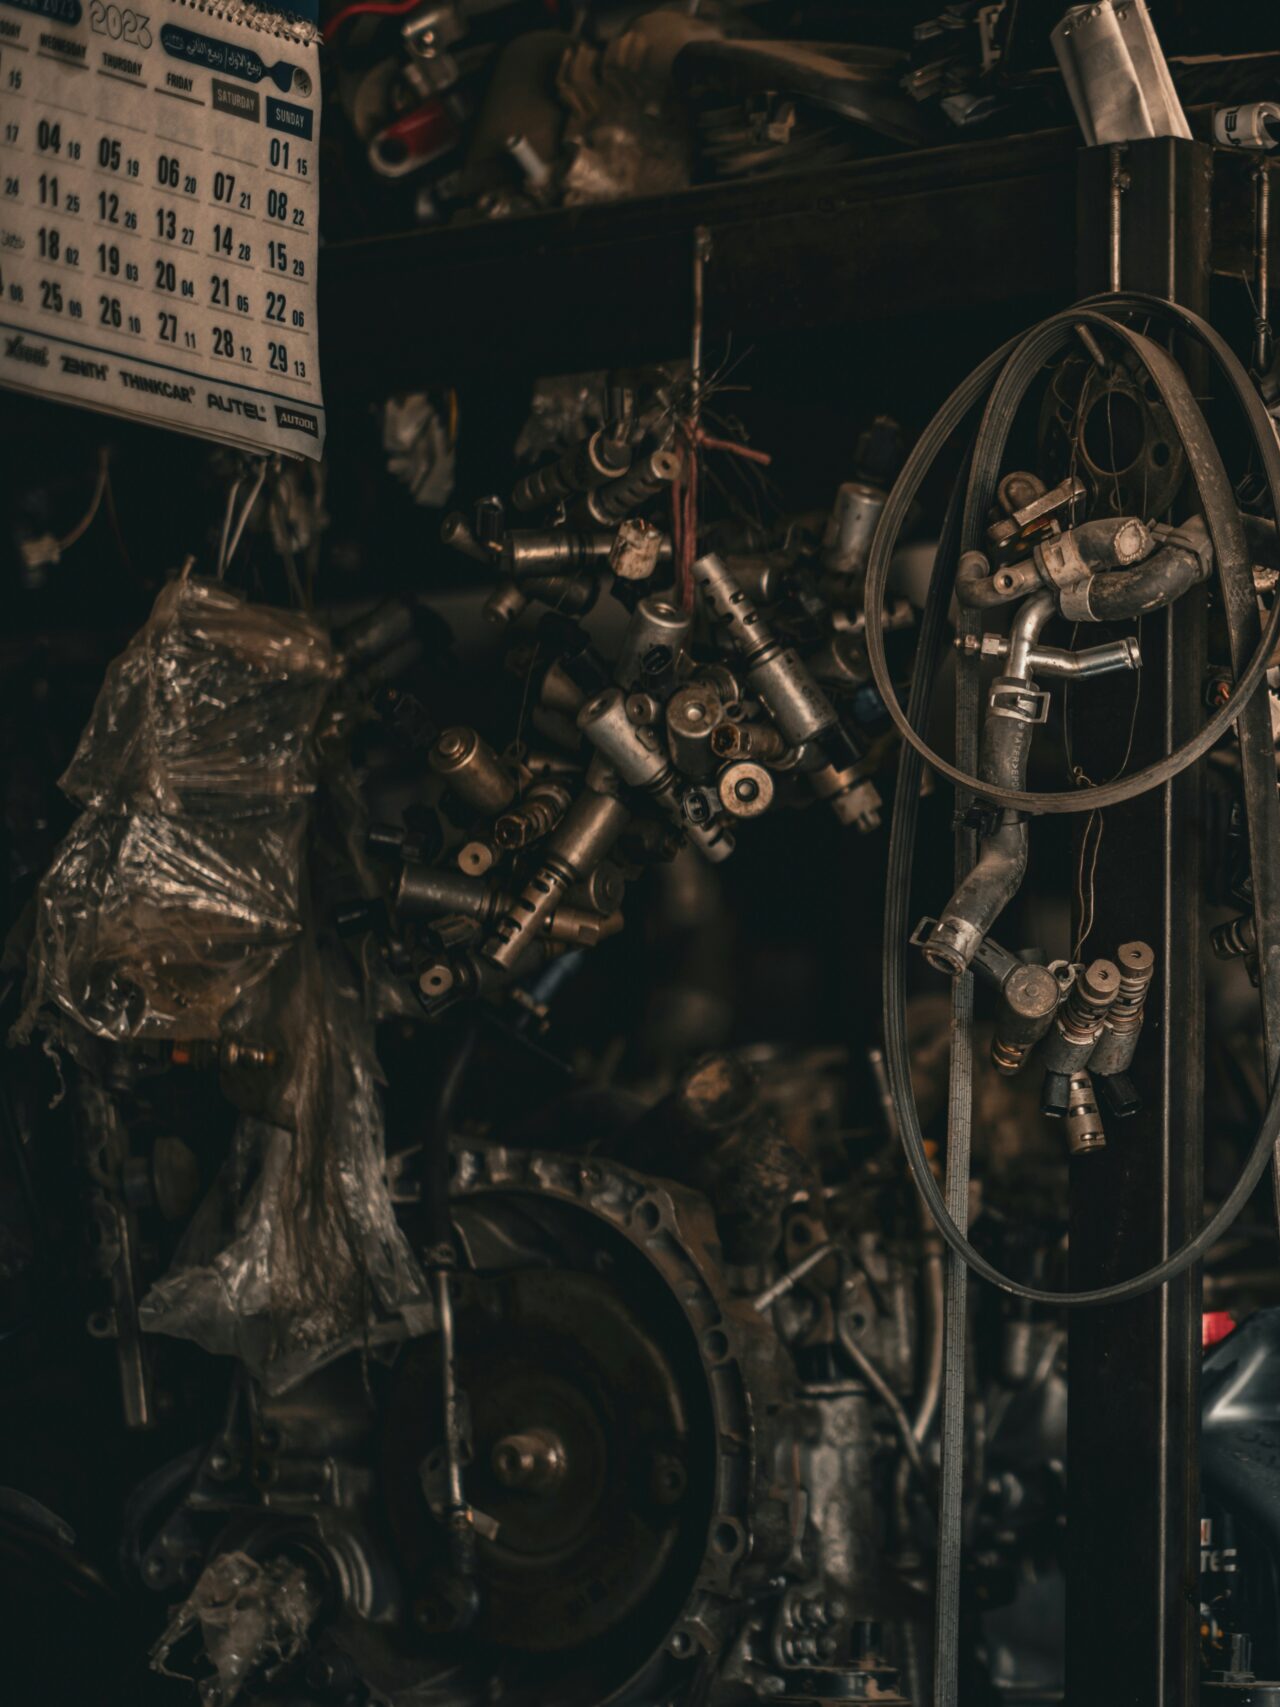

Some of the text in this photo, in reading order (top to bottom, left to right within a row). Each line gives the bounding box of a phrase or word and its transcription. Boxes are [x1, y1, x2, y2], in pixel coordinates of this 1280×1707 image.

[90, 0, 152, 49] 2023
[40, 33, 87, 58] WEDNESDAY
[102, 52, 143, 76] THURSDAY
[166, 73, 193, 92] FRIDAY
[217, 88, 255, 111] SATURDAY
[275, 107, 305, 128] SUNDAY
[7, 120, 305, 226] 17 04 18 05 19 06 20 07 21 08 22
[270, 138, 290, 169] 01
[296, 158, 307, 176] 15
[6, 174, 305, 276] 24 11 25 12 26 13 27 14 28 15 29
[39, 227, 60, 260] 18
[66, 247, 79, 266] 02
[98, 244, 120, 275] 19
[126, 264, 139, 282] 03
[156, 260, 176, 292] 20
[182, 280, 194, 297] 04
[211, 276, 230, 307] 21
[237, 295, 249, 313] 05
[266, 291, 286, 323] 22
[292, 310, 305, 327] 06
[41, 280, 63, 313] 25
[69, 300, 82, 318] 09
[100, 296, 122, 328] 26
[129, 316, 141, 334] 10
[158, 312, 177, 343] 27
[185, 331, 196, 349] 11
[213, 327, 234, 358] 28
[240, 346, 252, 364] 12
[268, 342, 288, 373] 29
[294, 361, 306, 378] 13
[60, 355, 107, 381] ZENITH
[119, 371, 192, 403] THINKCAR
[207, 393, 267, 422] AUTEL
